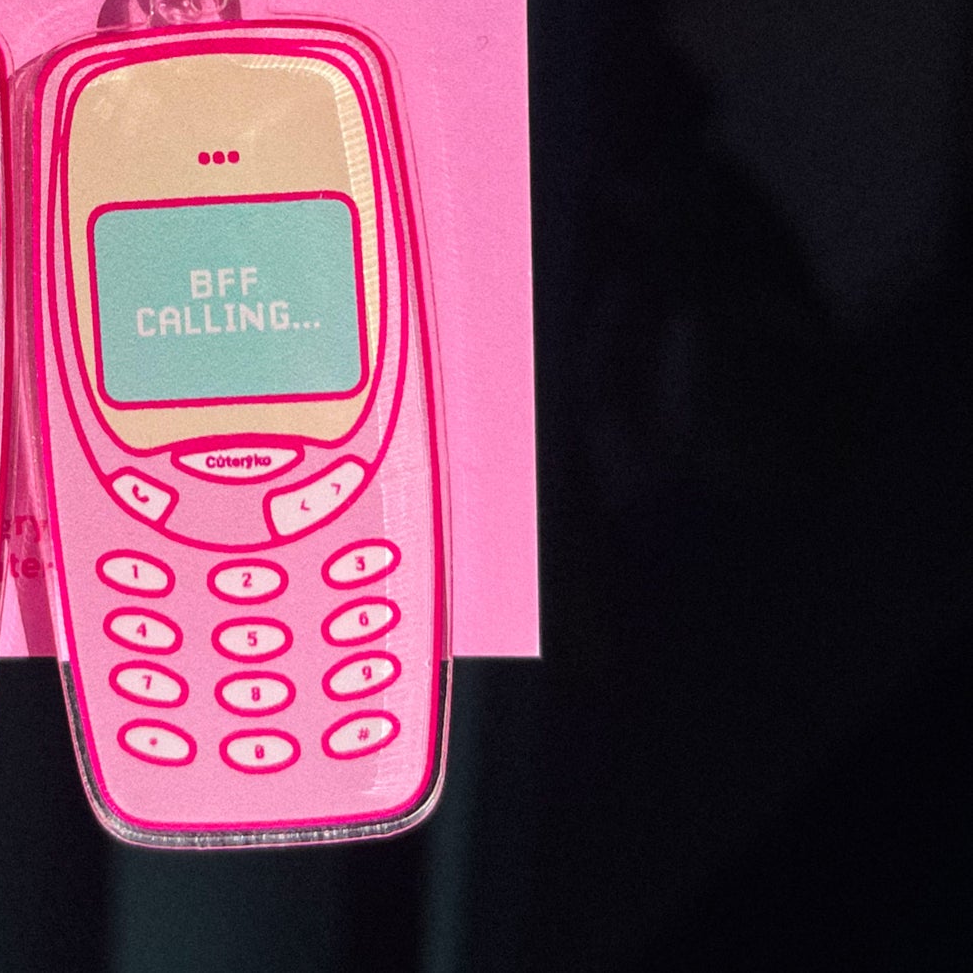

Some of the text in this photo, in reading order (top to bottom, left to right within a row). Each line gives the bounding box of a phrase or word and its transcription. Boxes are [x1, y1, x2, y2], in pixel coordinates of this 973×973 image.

[189, 266, 258, 300] BFF
[135, 299, 320, 337] CALLING...
[242, 572, 252, 588] 2
[355, 556, 366, 572] 3
[136, 611, 369, 647] 4 5 6
[142, 665, 372, 702] 7 8 9
